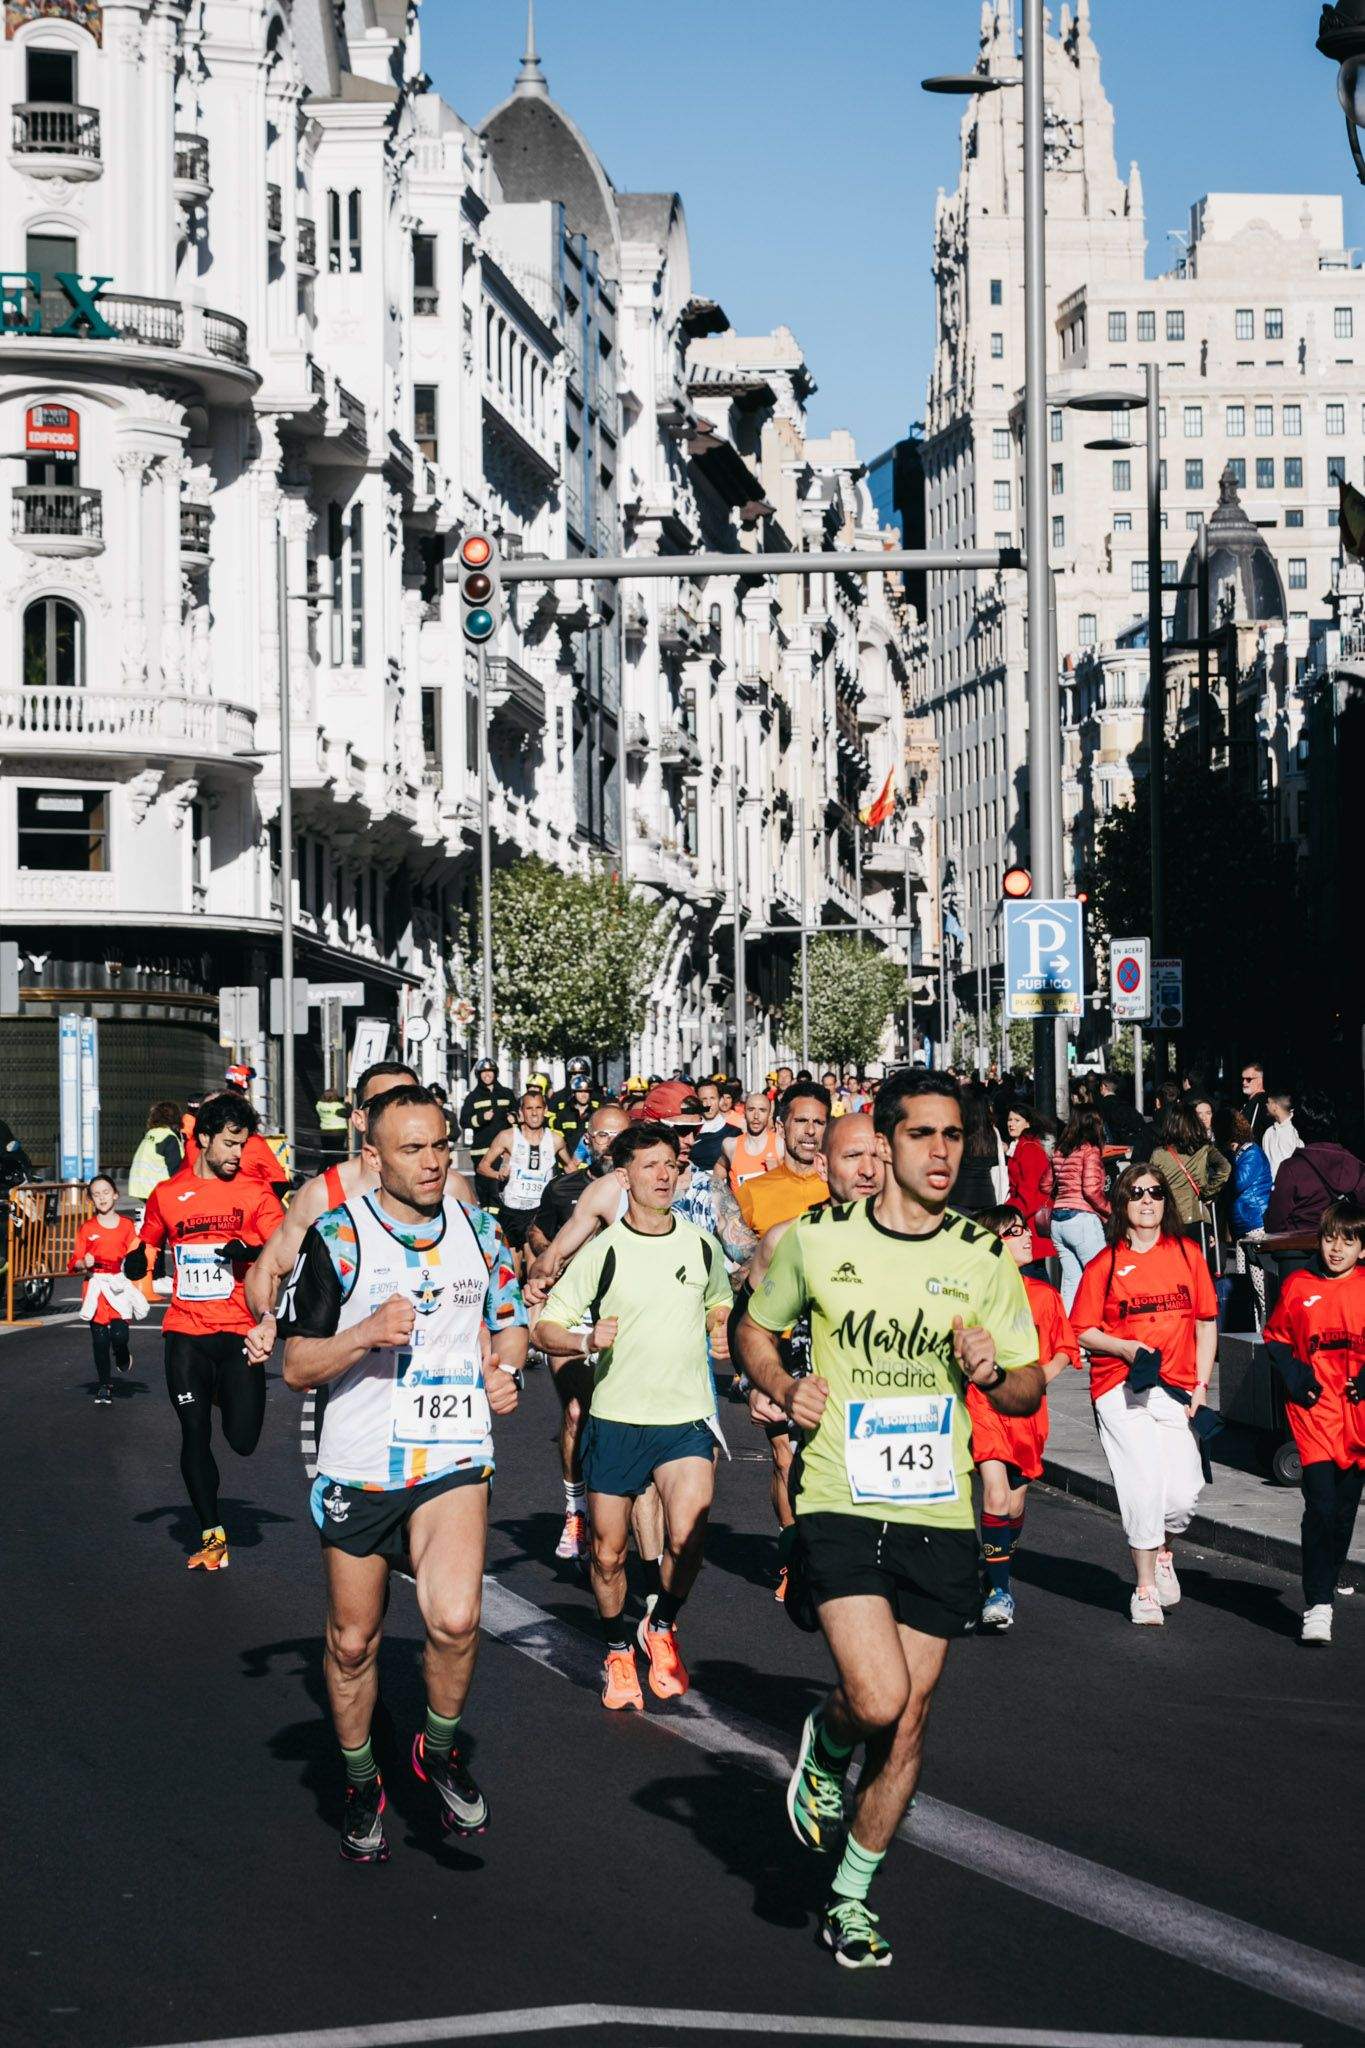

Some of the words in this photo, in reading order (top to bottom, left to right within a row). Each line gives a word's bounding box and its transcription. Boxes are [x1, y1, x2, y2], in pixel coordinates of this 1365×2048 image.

[1021, 919, 1066, 978] P
[186, 1268, 222, 1283] 1114
[453, 1279, 483, 1291] SHAVE
[1134, 1294, 1188, 1305] BOMBEROS
[413, 1395, 471, 1418] 1821
[880, 1444, 933, 1471] 143
